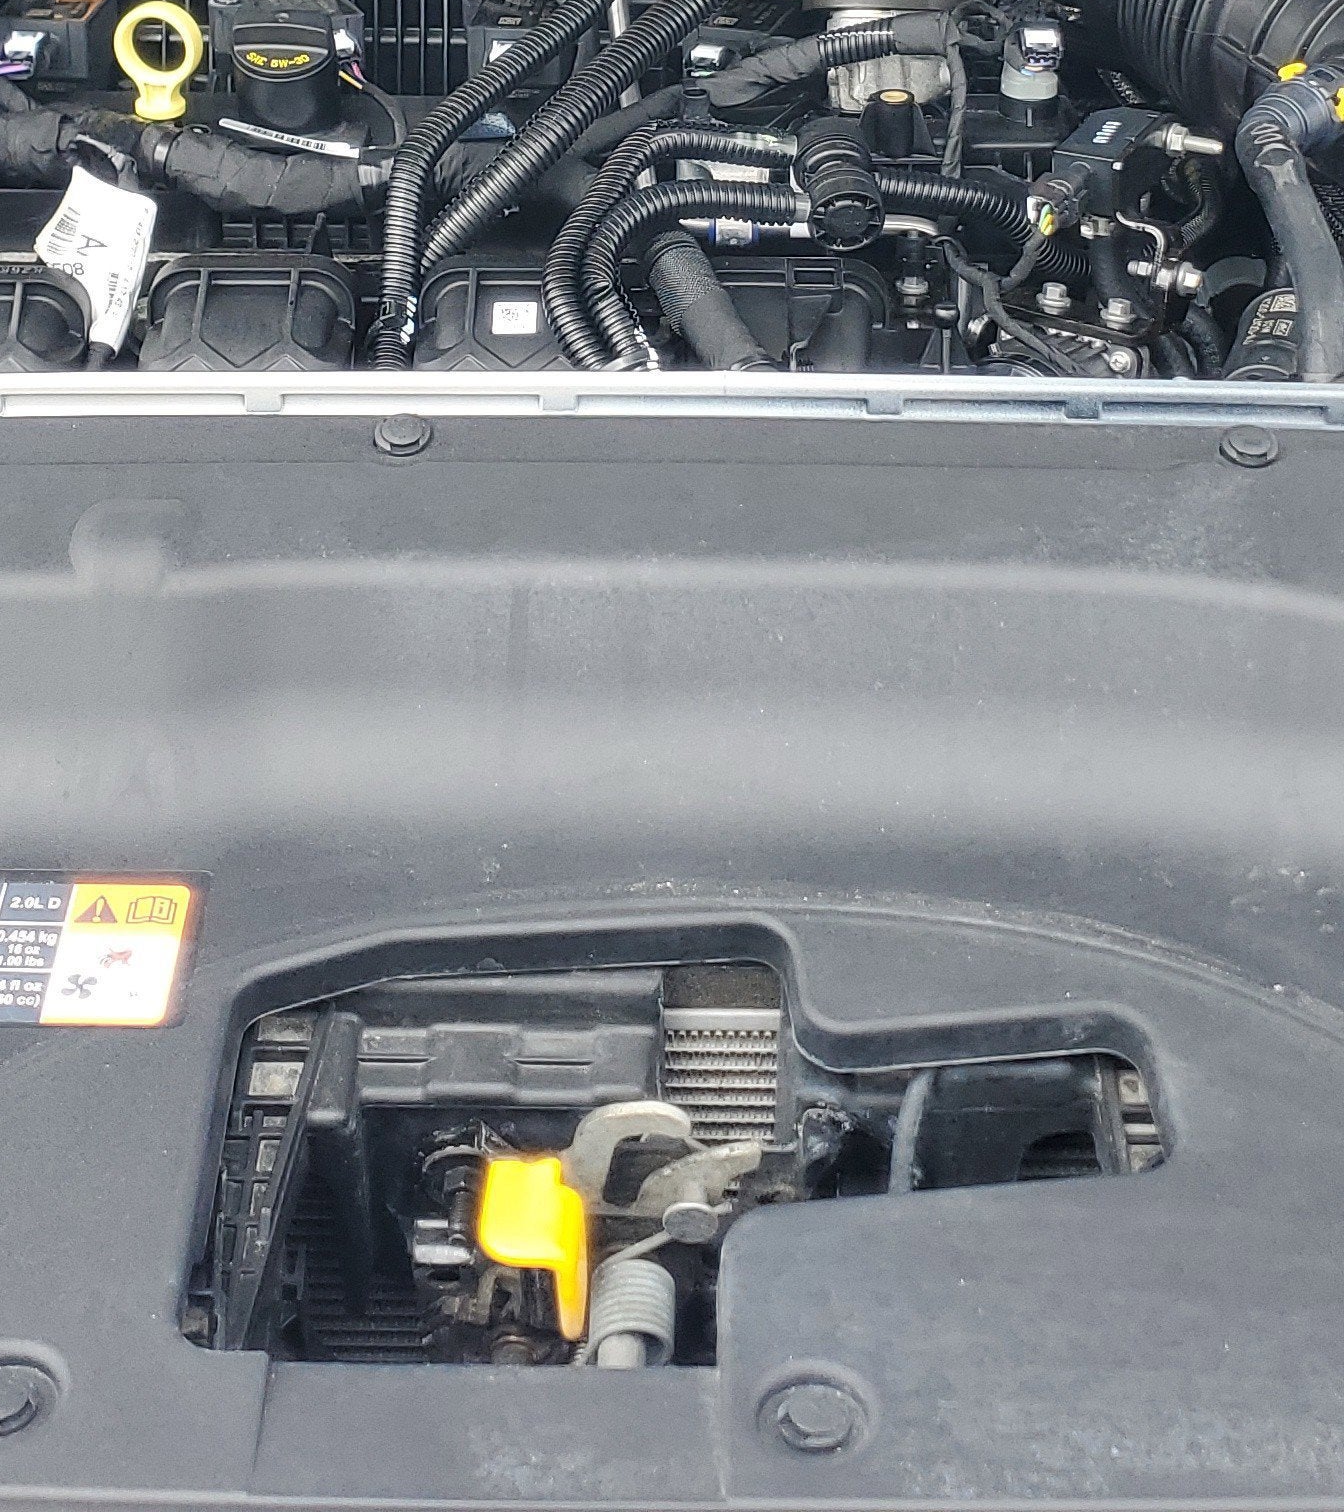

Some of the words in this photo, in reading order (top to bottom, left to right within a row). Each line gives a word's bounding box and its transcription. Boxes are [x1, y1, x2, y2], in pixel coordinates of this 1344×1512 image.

[246, 52, 267, 66] SAE
[10, 896, 44, 909] 2.0L
[47, 897, 61, 909] D
[38, 930, 59, 946] kg
[24, 946, 41, 955] oz
[24, 955, 45, 967] lbs
[9, 979, 21, 991] fl
[23, 982, 44, 992] oz
[16, 994, 41, 1008] cc)
